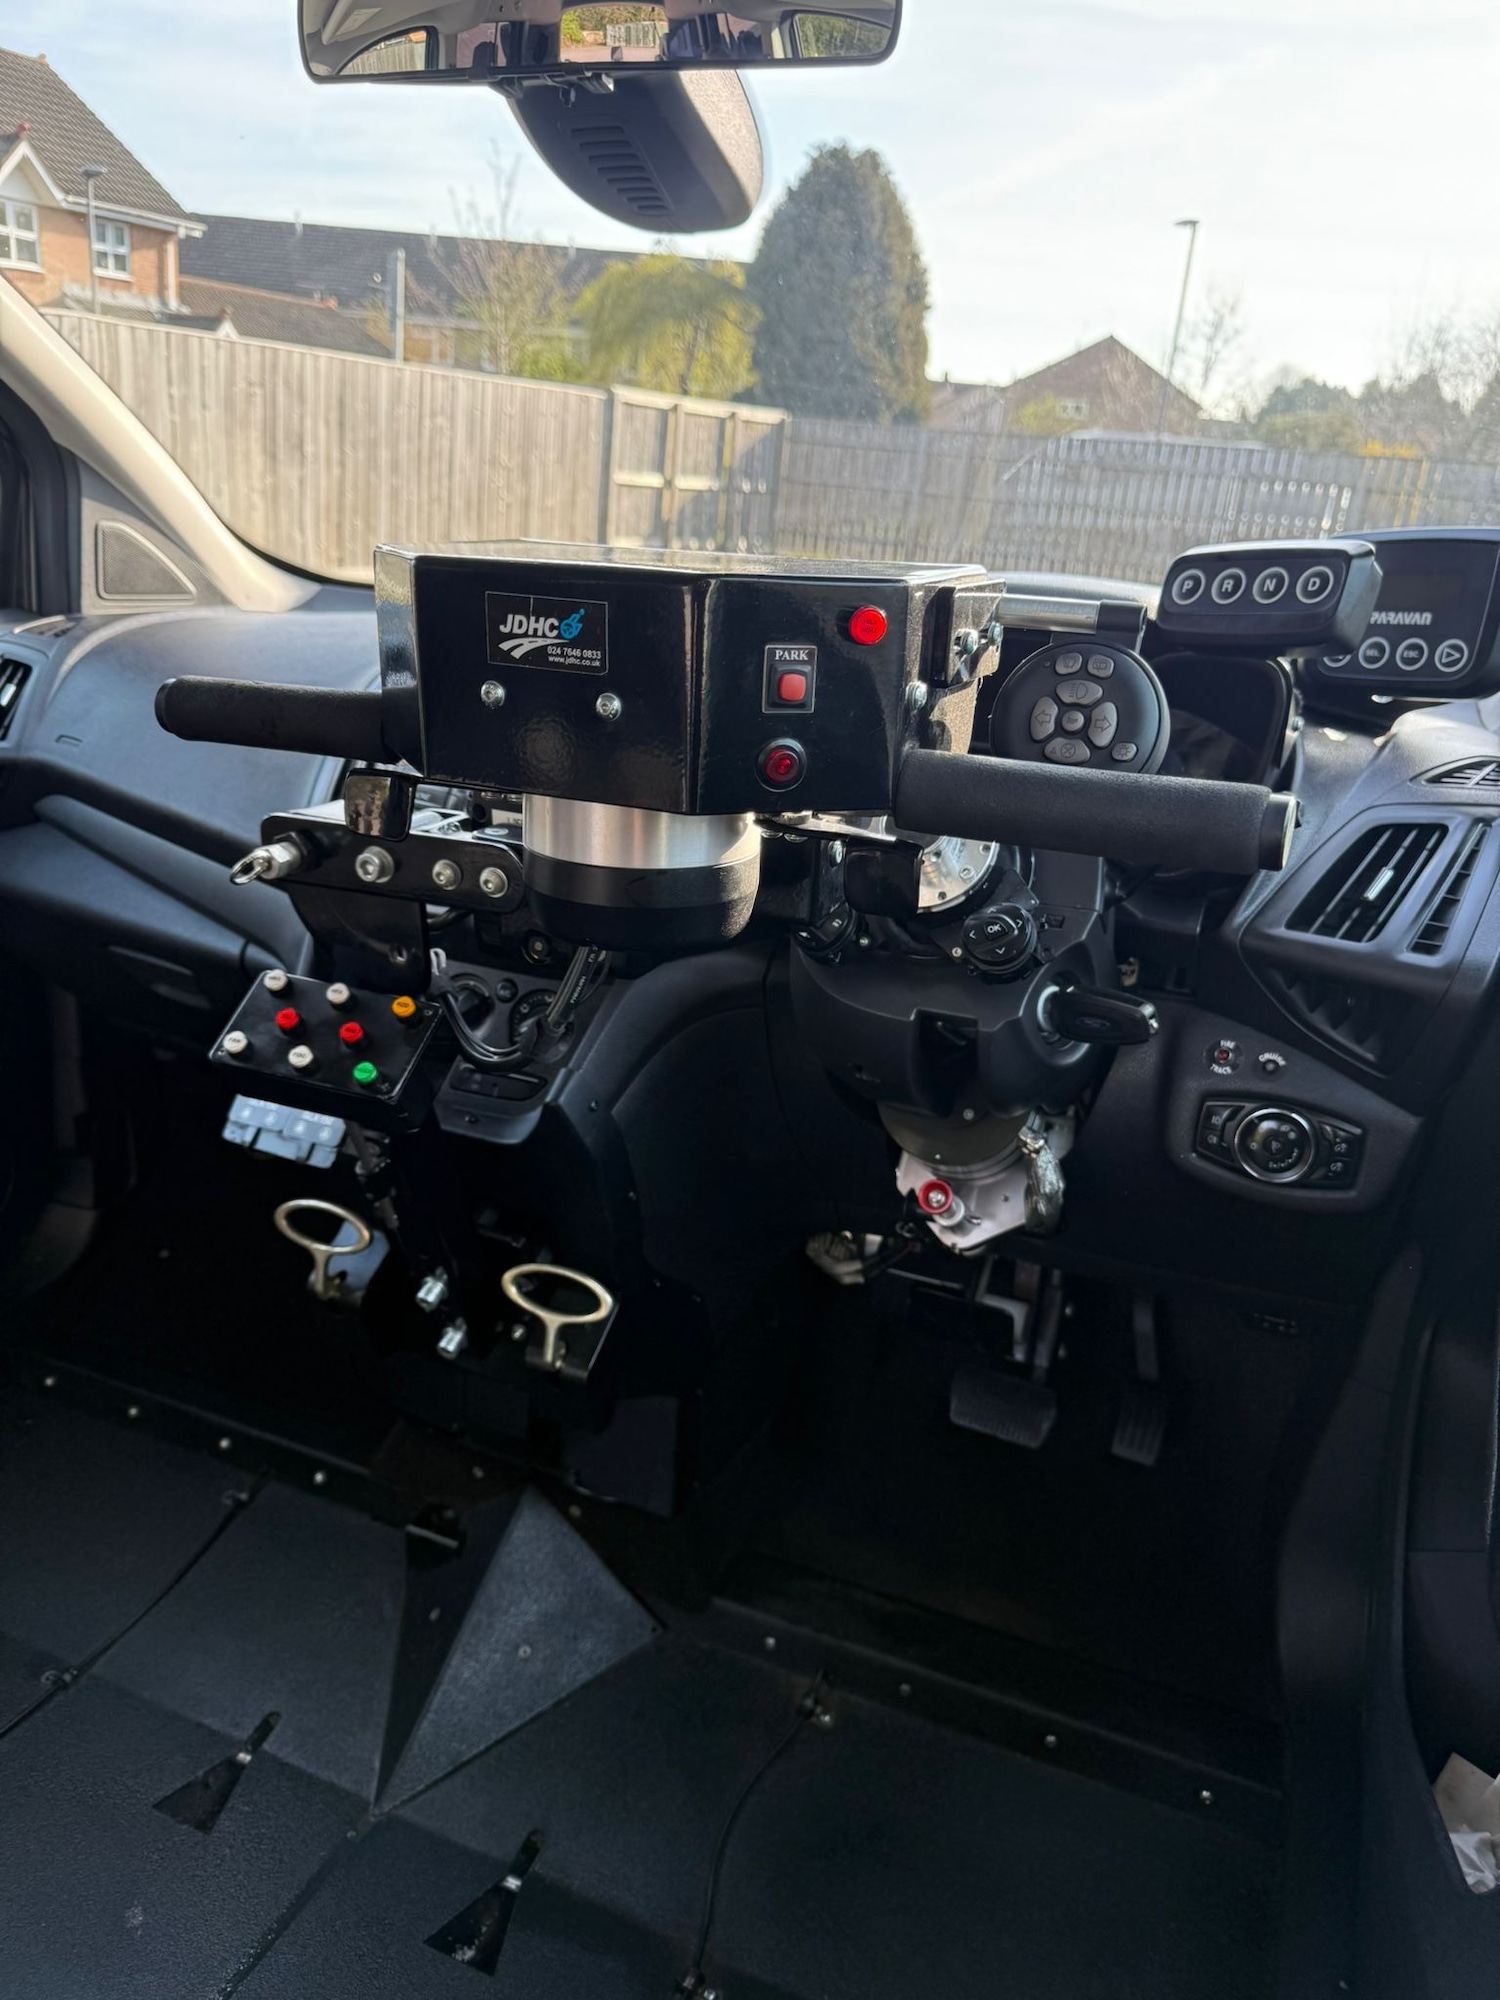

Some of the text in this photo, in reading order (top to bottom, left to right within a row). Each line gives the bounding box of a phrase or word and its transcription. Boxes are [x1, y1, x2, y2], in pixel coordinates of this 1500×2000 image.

[1181, 578, 1320, 593] P R N D
[1370, 611, 1432, 625] PARAVAN
[499, 613, 559, 638] JDHC
[547, 645, 602, 659] 024 7646 0833
[775, 649, 809, 661] PARK
[987, 923, 1002, 933] OK
[1220, 1039, 1236, 1049] FIRE
[1258, 1052, 1287, 1066] CRUISE
